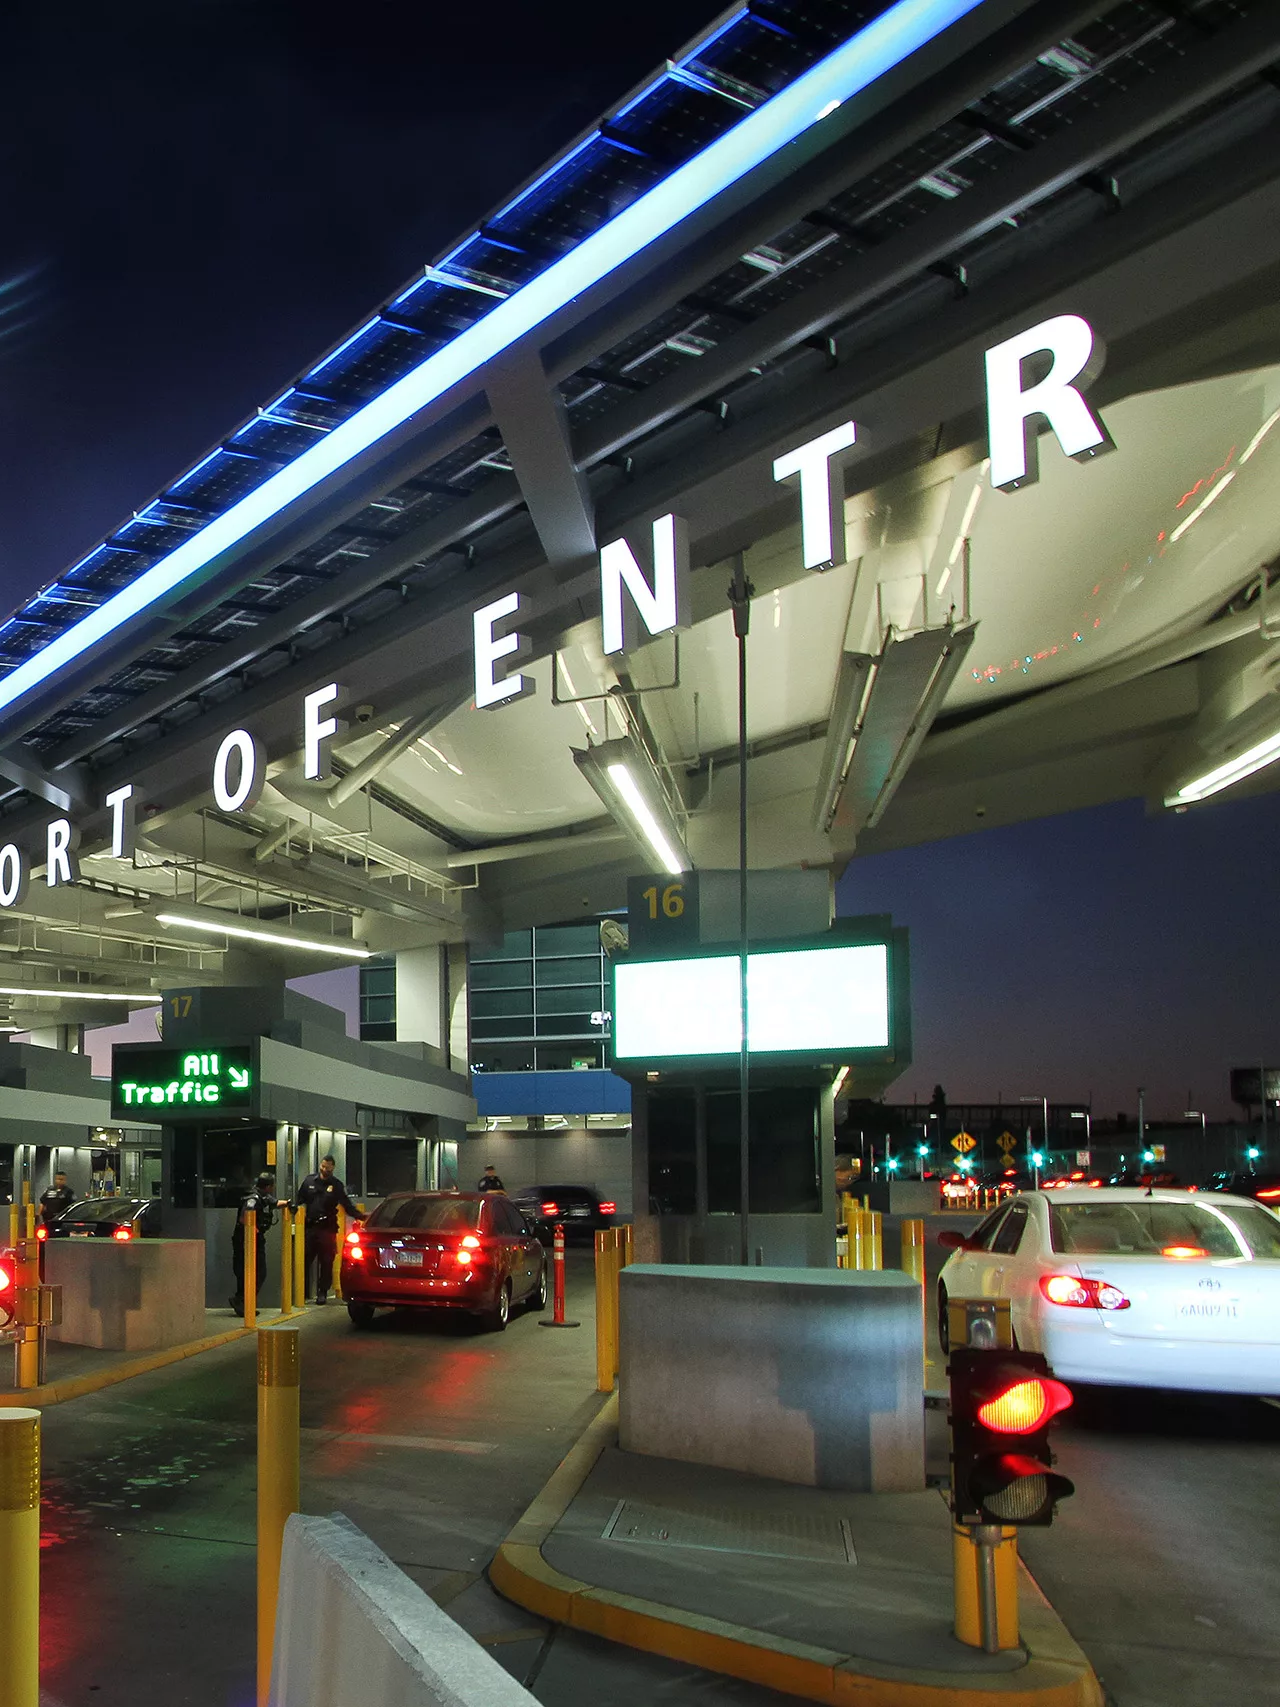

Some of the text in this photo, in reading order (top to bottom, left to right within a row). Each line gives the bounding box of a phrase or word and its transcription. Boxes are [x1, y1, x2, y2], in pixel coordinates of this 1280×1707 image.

[213, 681, 339, 813] OF
[472, 313, 1105, 709] ENTR
[642, 883, 685, 920] 16
[170, 995, 193, 1018] 17
[183, 1053, 220, 1077] All
[121, 1081, 220, 1104] Traffic
